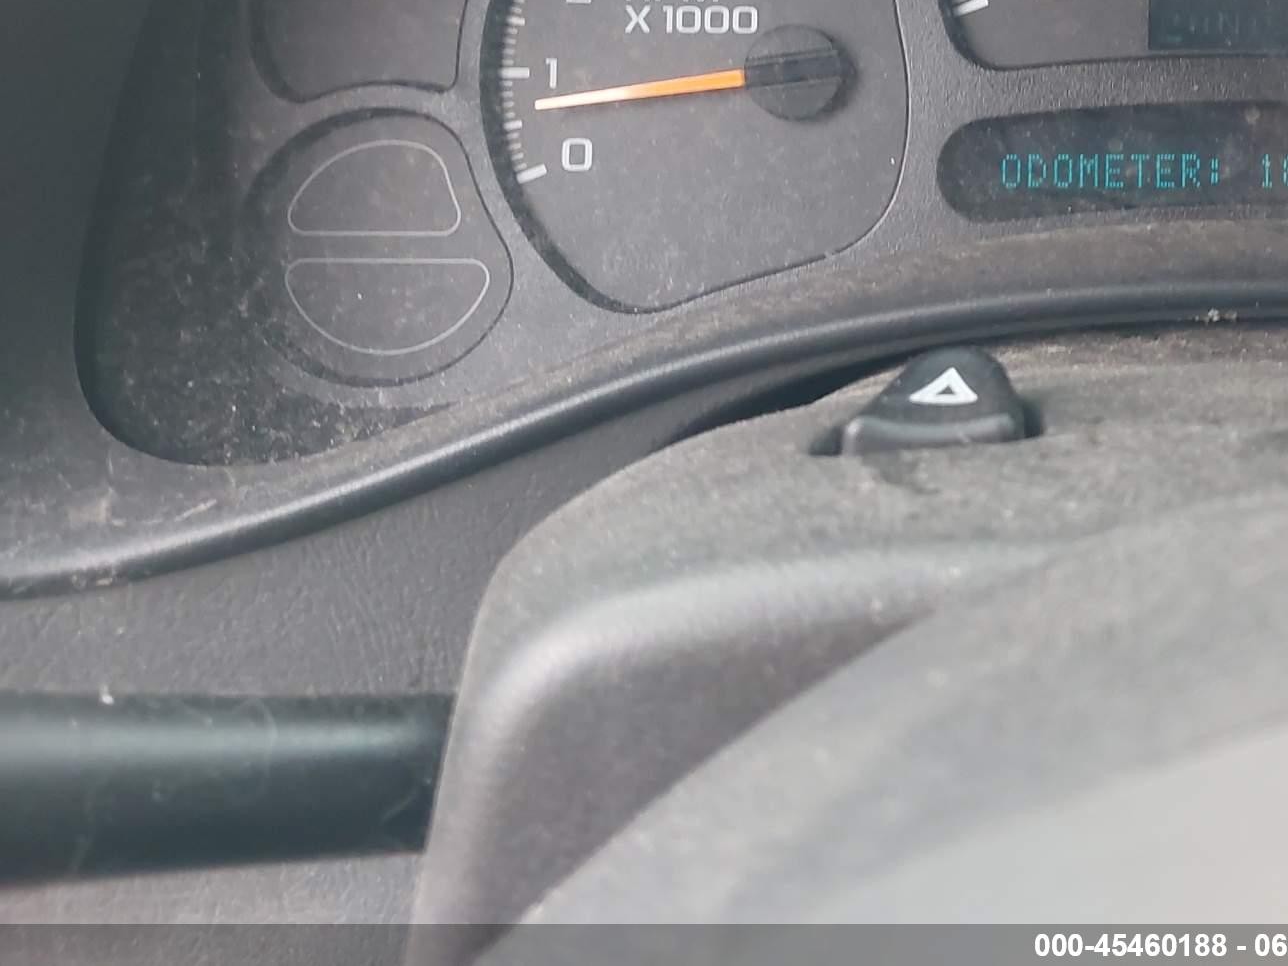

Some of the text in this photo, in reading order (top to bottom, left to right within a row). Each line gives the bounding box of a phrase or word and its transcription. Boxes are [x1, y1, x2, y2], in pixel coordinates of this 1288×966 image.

[626, 5, 757, 33] X 1000
[546, 58, 557, 88] 1
[562, 138, 592, 171] 0
[1000, 154, 1218, 189] ODOMETER:
